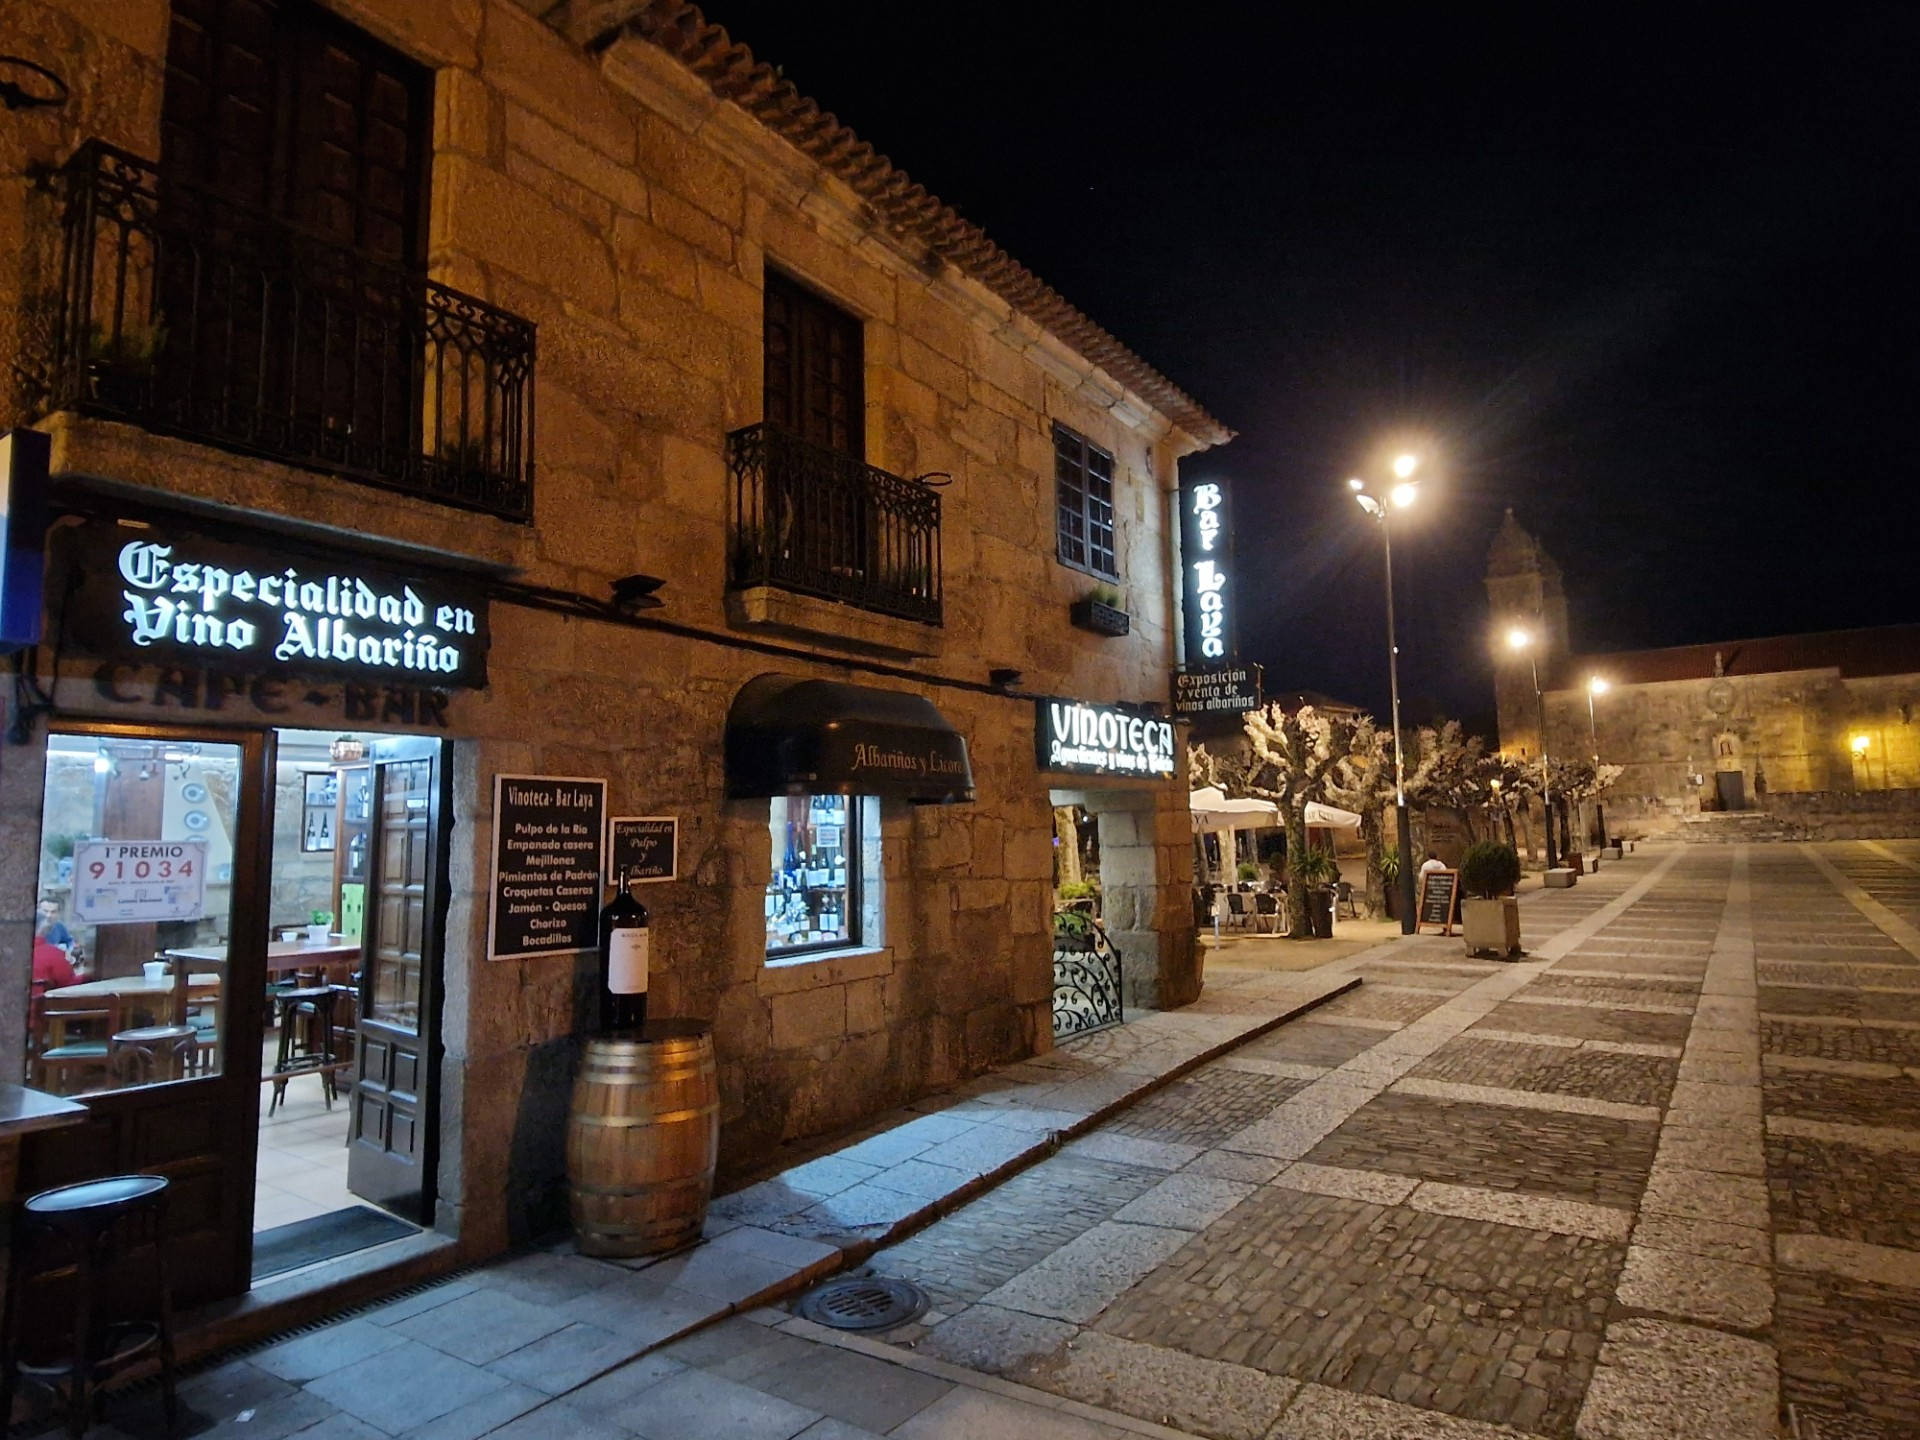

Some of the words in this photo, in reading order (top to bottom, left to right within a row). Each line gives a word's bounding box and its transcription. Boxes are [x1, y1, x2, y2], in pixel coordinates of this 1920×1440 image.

[1193, 482, 1222, 551] Bar
[118, 540, 424, 628] Especialidad
[435, 601, 476, 636] en
[1193, 560, 1227, 658] Laya
[122, 590, 256, 651] Vino
[274, 612, 460, 673] Albariño
[1177, 690, 1184, 699] y
[1188, 685, 1220, 698] venta
[1225, 682, 1239, 695] de
[1175, 700, 1204, 712] vinos
[1206, 694, 1255, 710] albariños
[1051, 703, 1174, 755] VINOTECA
[851, 742, 917, 771] Albariños
[919, 757, 927, 776] y
[556, 788, 571, 807] Bar
[573, 788, 594, 812] Laya
[515, 823, 543, 836] Pulpo
[545, 823, 558, 834] de
[561, 823, 570, 834] la
[507, 838, 561, 852] Empanada
[563, 841, 594, 850] casera
[630, 836, 658, 850] Pulpo
[119, 846, 183, 859] PREMIO
[639, 852, 646, 863] y
[526, 854, 576, 868] Mejillones
[499, 871, 548, 882] Pimientos
[550, 871, 563, 880] de
[565, 870, 599, 880] Padrón
[630, 864, 663, 876] lbariño
[503, 886, 554, 899] Croquetas
[556, 885, 594, 896] Caseras
[508, 902, 543, 914] Jamón
[552, 901, 588, 912] Quesos
[530, 917, 567, 930] Chorizo
[522, 933, 572, 946] Bocadillos
